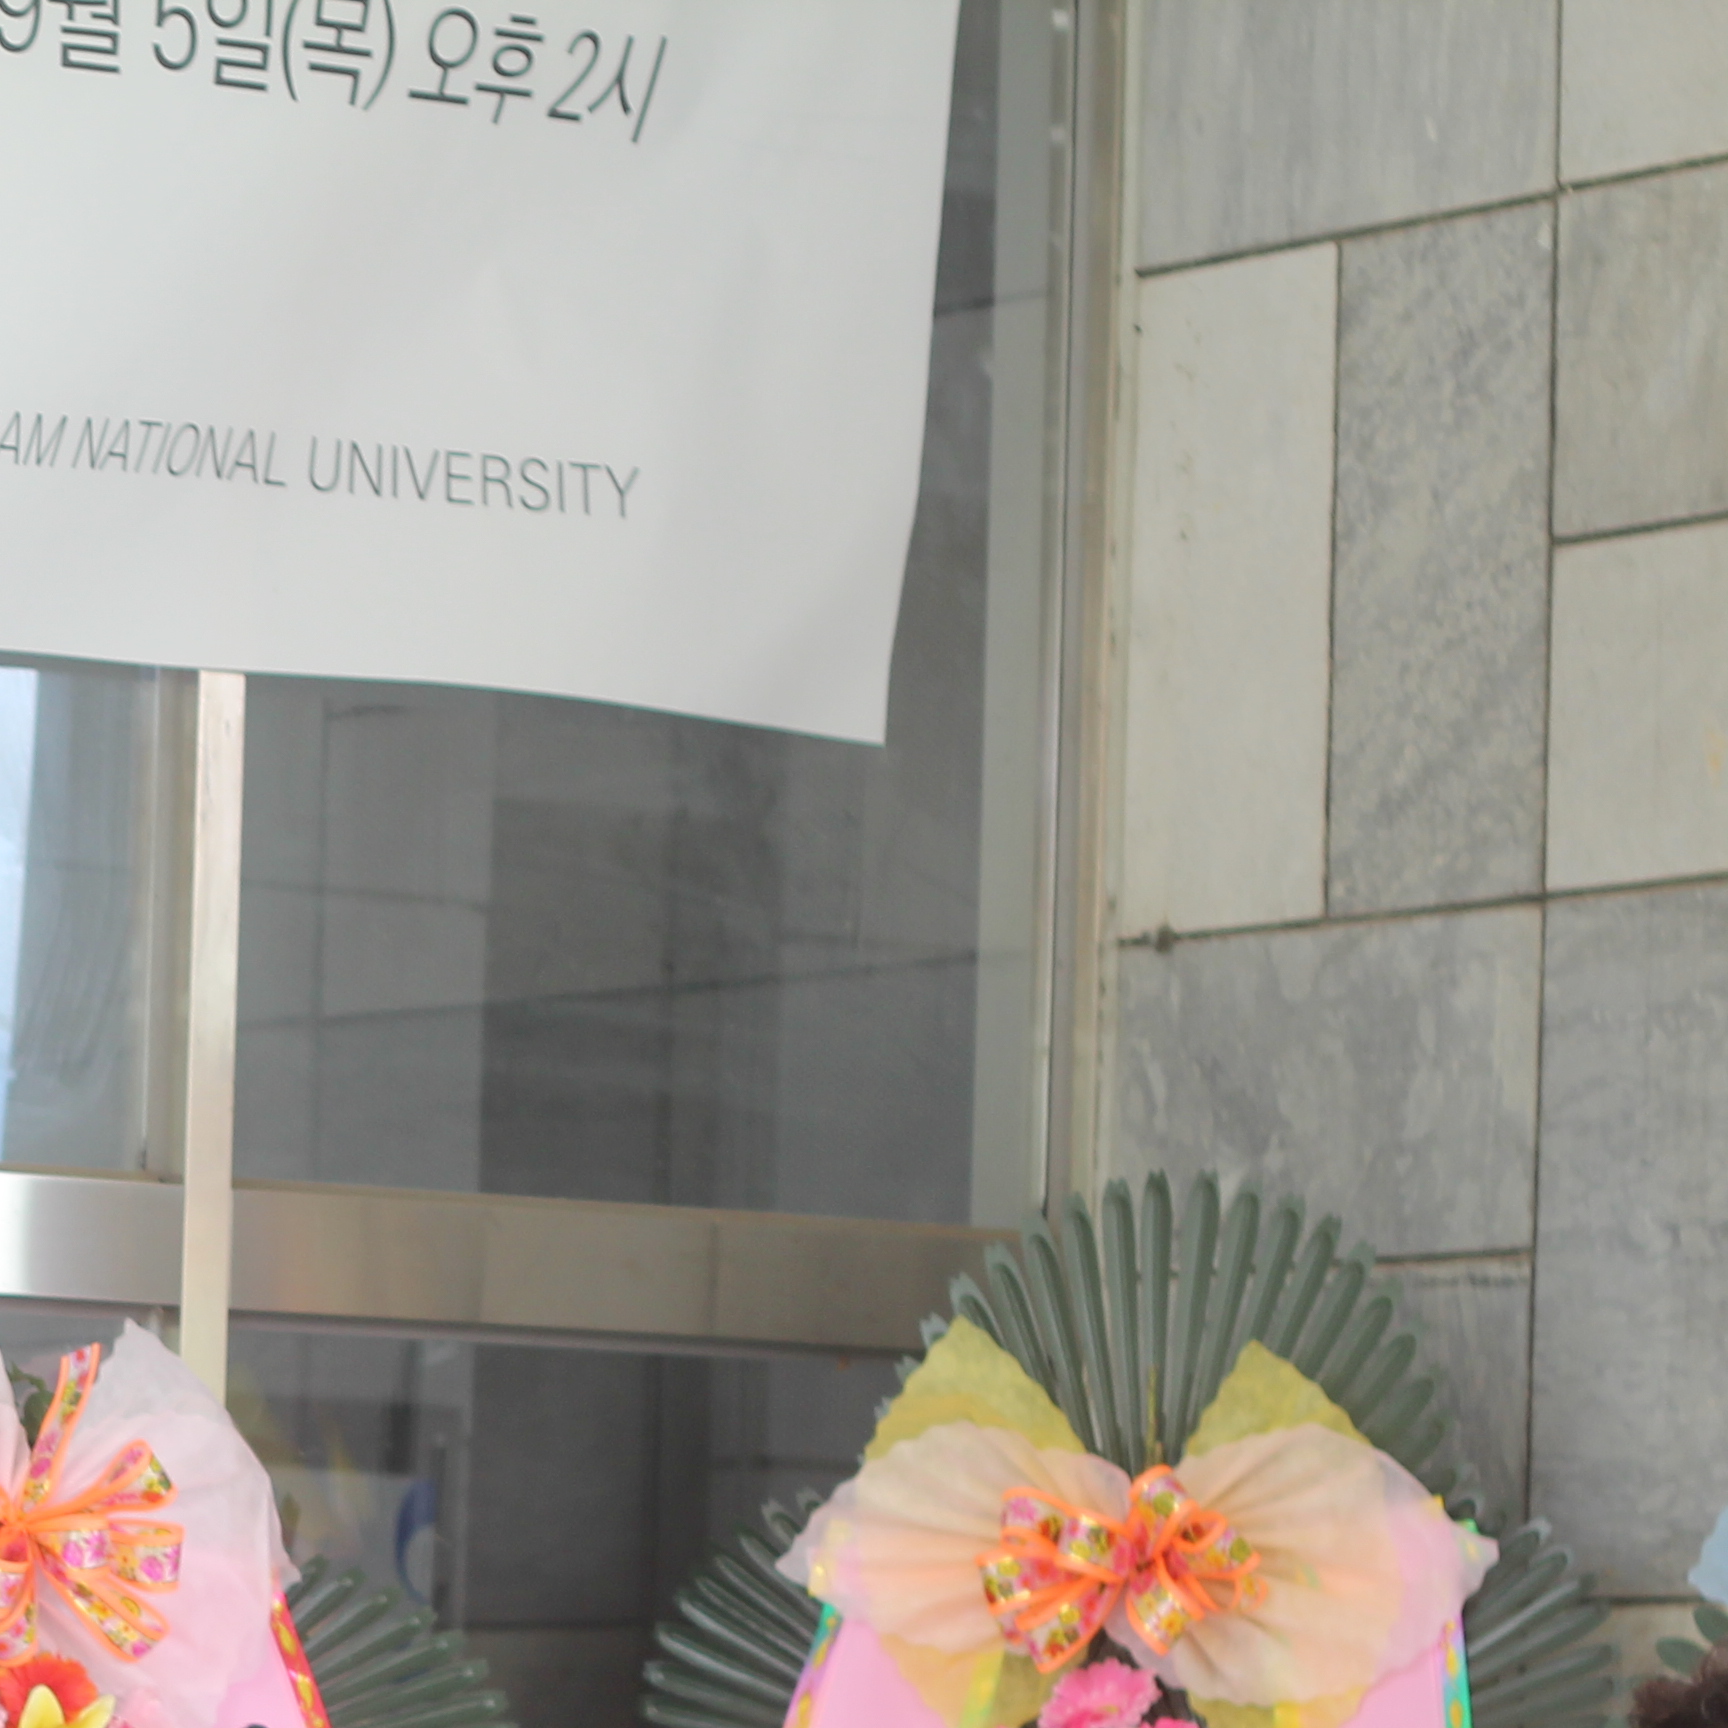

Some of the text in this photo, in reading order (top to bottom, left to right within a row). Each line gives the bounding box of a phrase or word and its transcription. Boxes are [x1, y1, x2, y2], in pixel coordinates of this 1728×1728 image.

[406, 7, 545, 125] 오후
[72, 416, 287, 489] NATIONAL
[308, 436, 640, 520] UNIVERSITY
